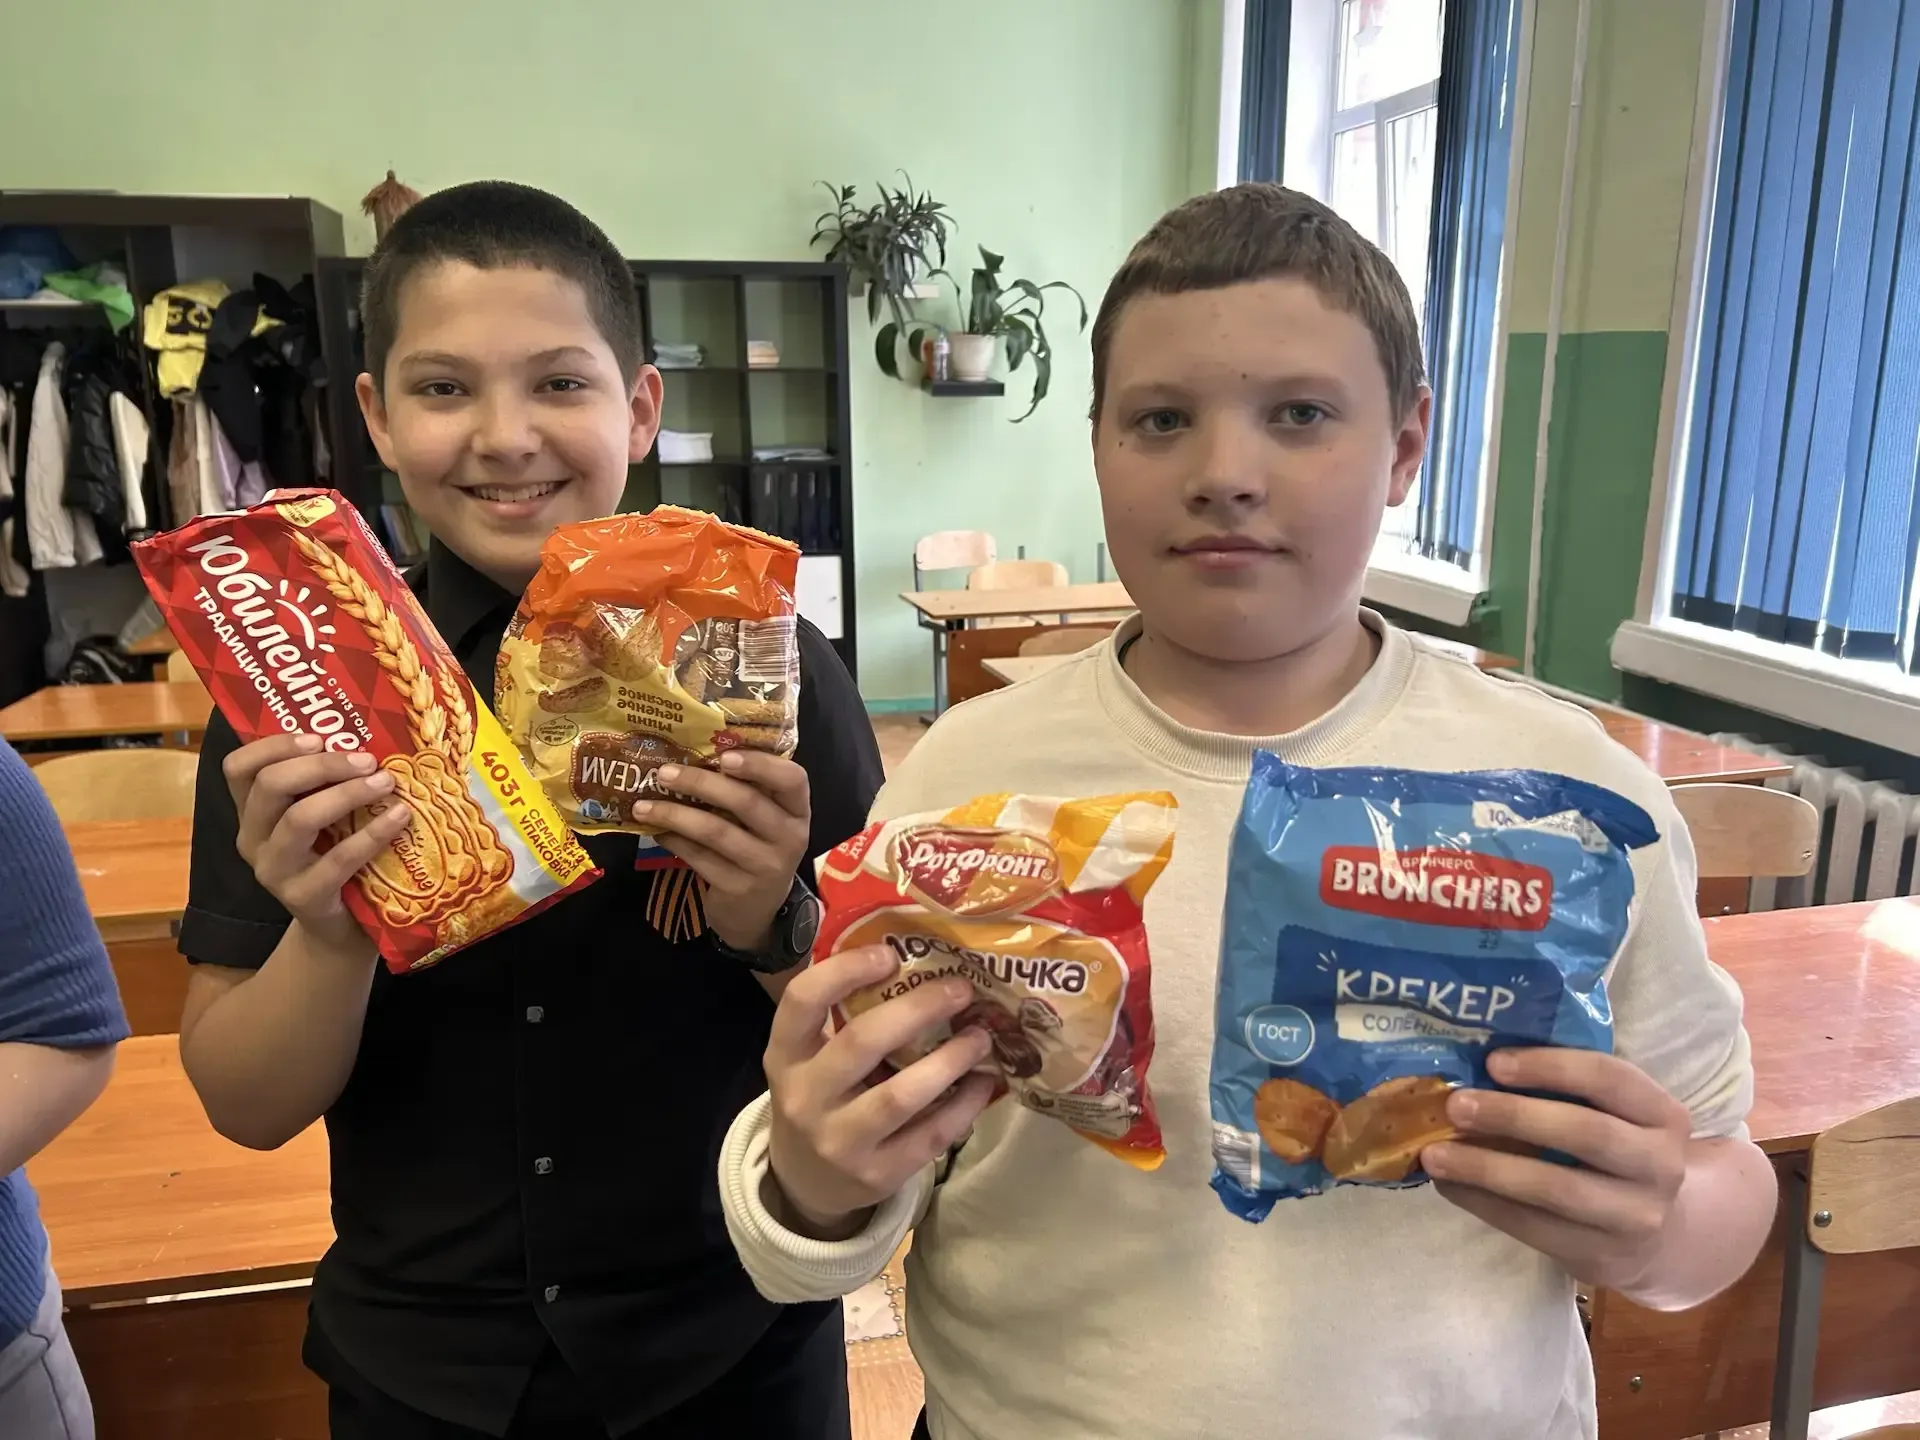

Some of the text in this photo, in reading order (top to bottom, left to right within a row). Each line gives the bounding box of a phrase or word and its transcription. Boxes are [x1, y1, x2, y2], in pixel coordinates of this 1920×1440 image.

[186, 534, 361, 753] Юбилейное
[334, 687, 354, 712] 1913
[617, 686, 684, 712] овсяное
[617, 698, 684, 724] печенье
[481, 751, 526, 808] 403 г
[520, 814, 572, 880] УПАКОВКА
[1332, 857, 1544, 918] BRUNCHERS
[880, 963, 993, 1001] карамель
[1335, 968, 1516, 1022] КРЕКЕР
[1257, 1022, 1303, 1044] ГОСТ
